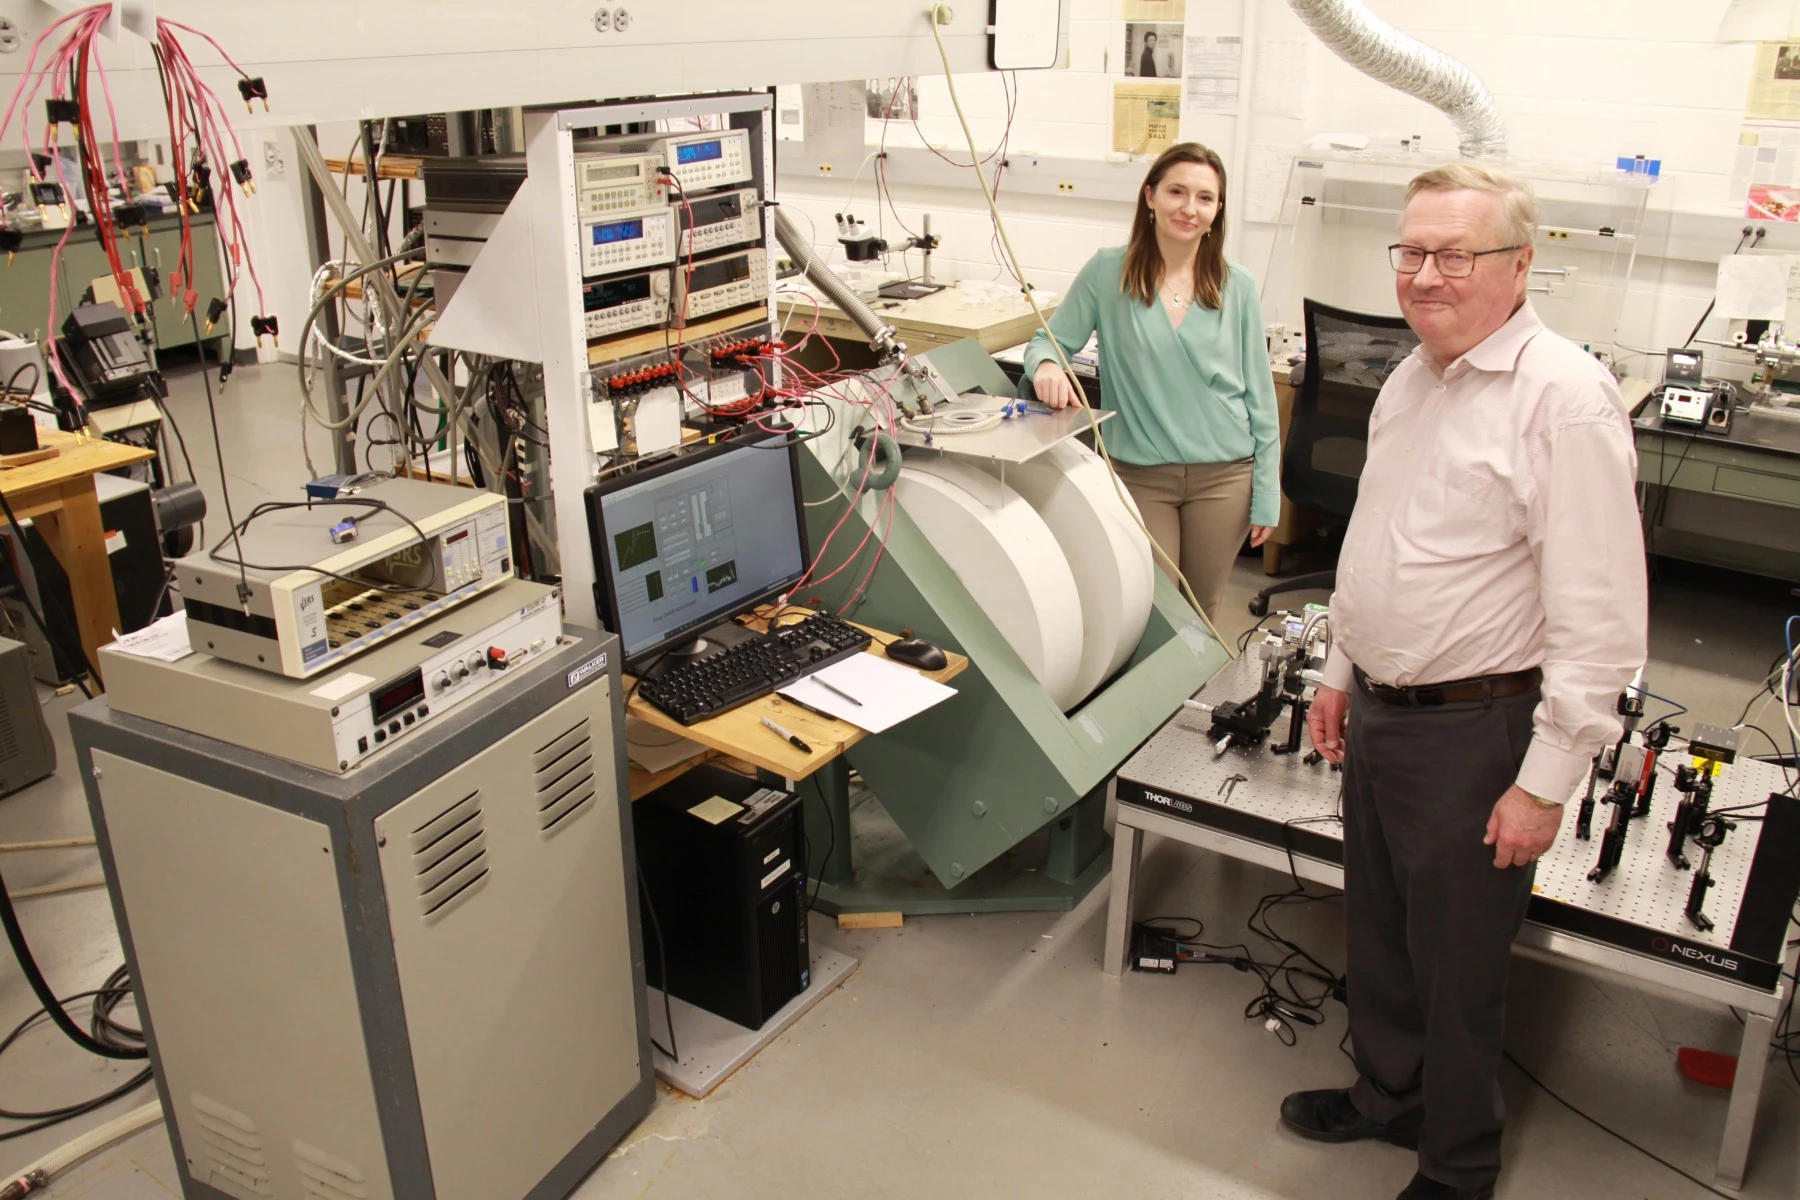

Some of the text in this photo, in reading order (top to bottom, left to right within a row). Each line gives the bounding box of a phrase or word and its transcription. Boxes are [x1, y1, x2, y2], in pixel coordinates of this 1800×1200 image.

[579, 655, 604, 674] WALKER
[1144, 790, 1193, 812] THORLABS
[1671, 943, 1739, 971] NEXUS
